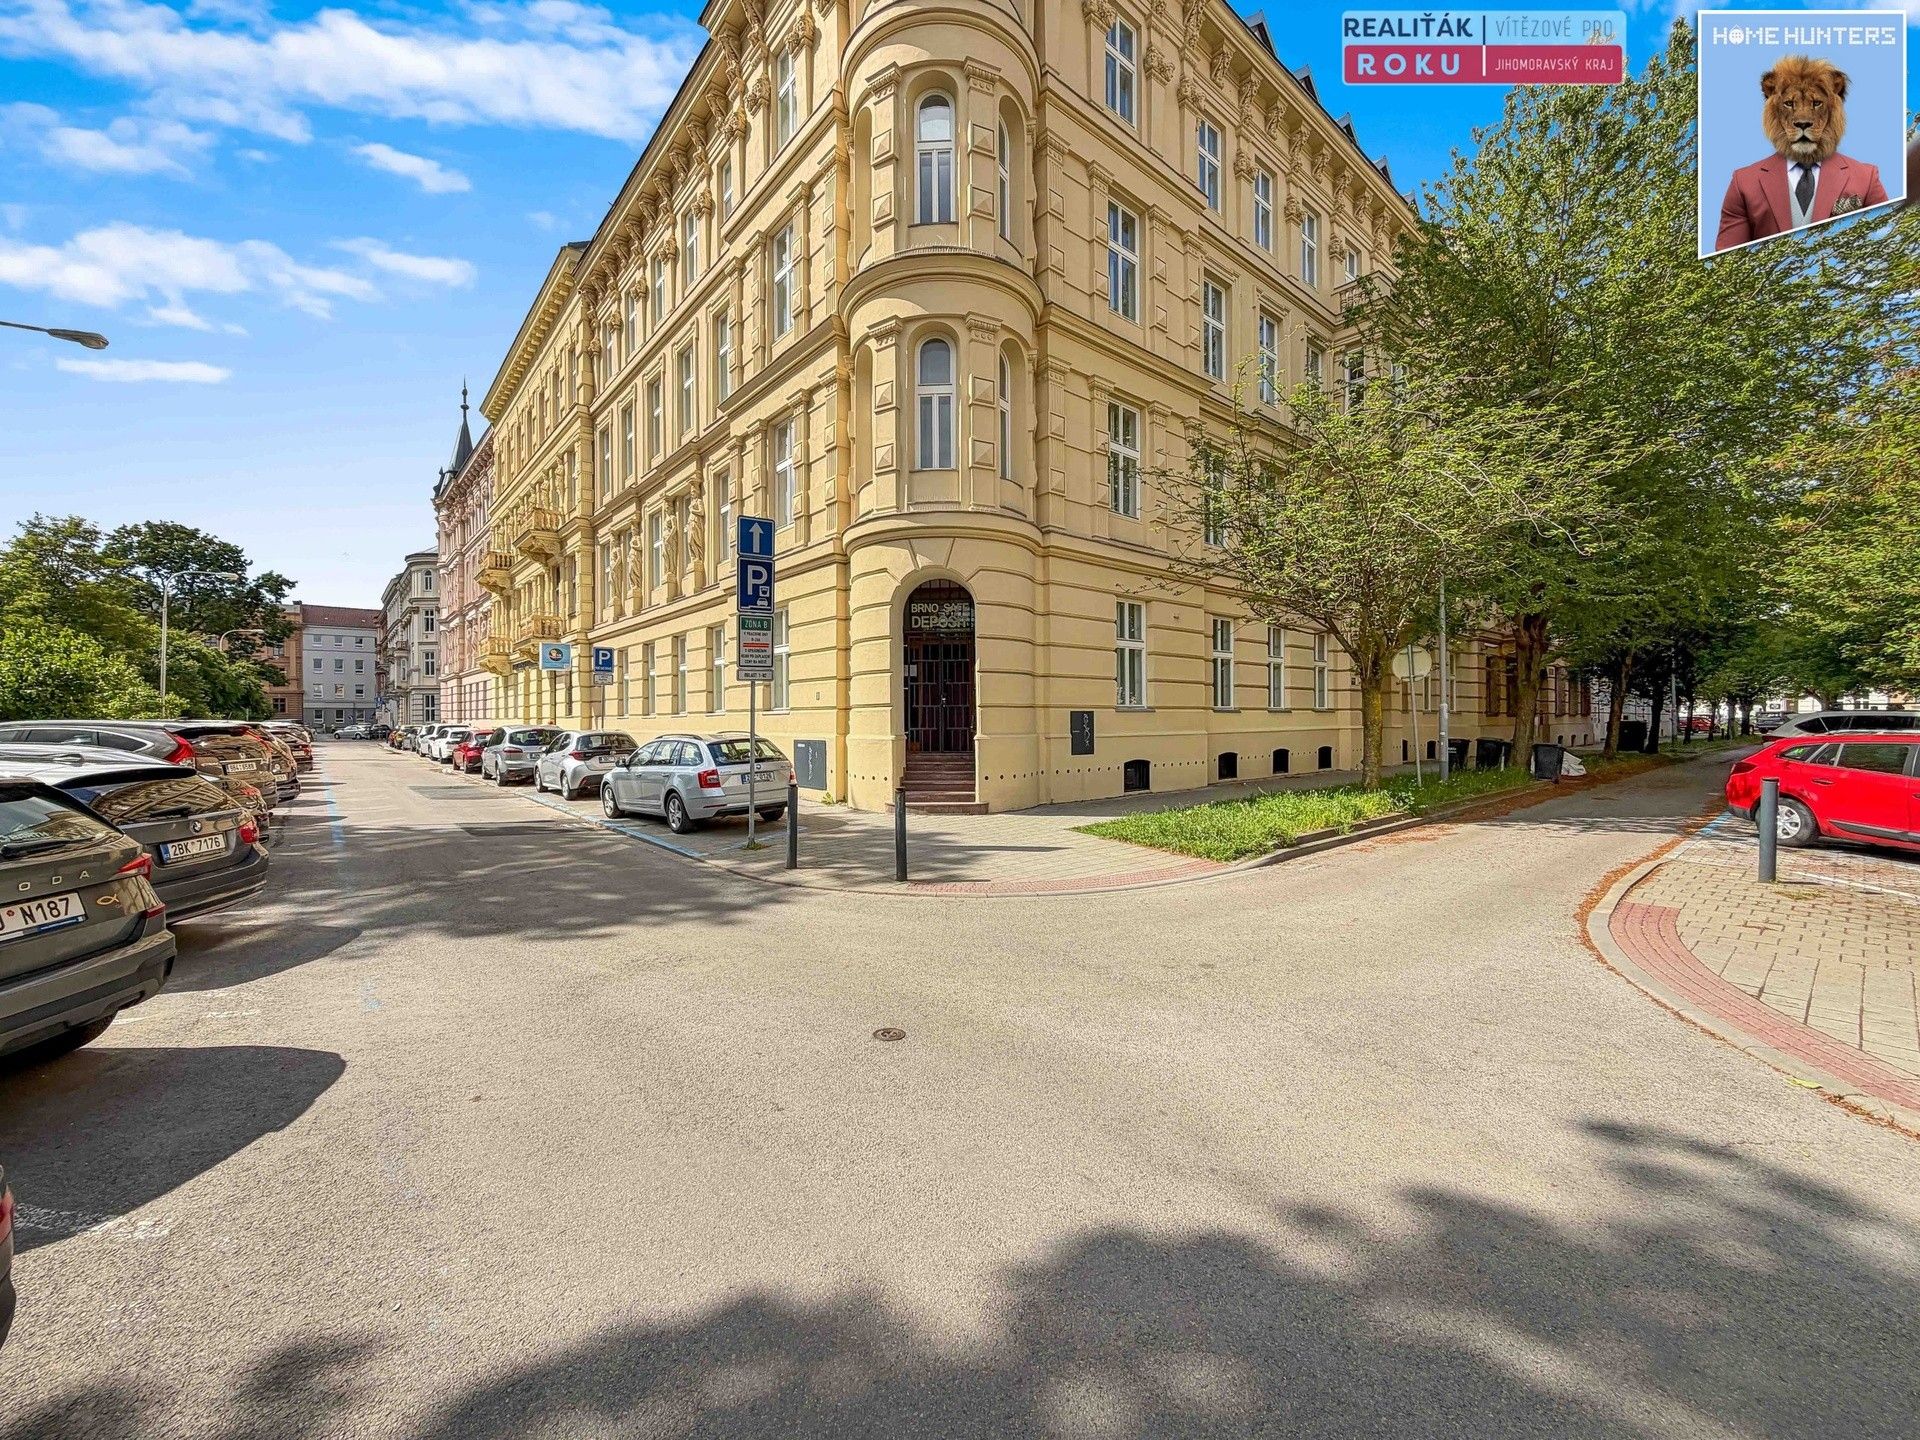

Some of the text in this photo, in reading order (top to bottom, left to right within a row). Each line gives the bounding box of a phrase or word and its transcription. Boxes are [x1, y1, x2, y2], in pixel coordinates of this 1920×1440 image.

[747, 565, 768, 595] P
[911, 603, 939, 613] BRNO
[598, 650, 611, 665] P
[171, 836, 221, 857] 2BK 7176
[20, 897, 70, 925] N187
